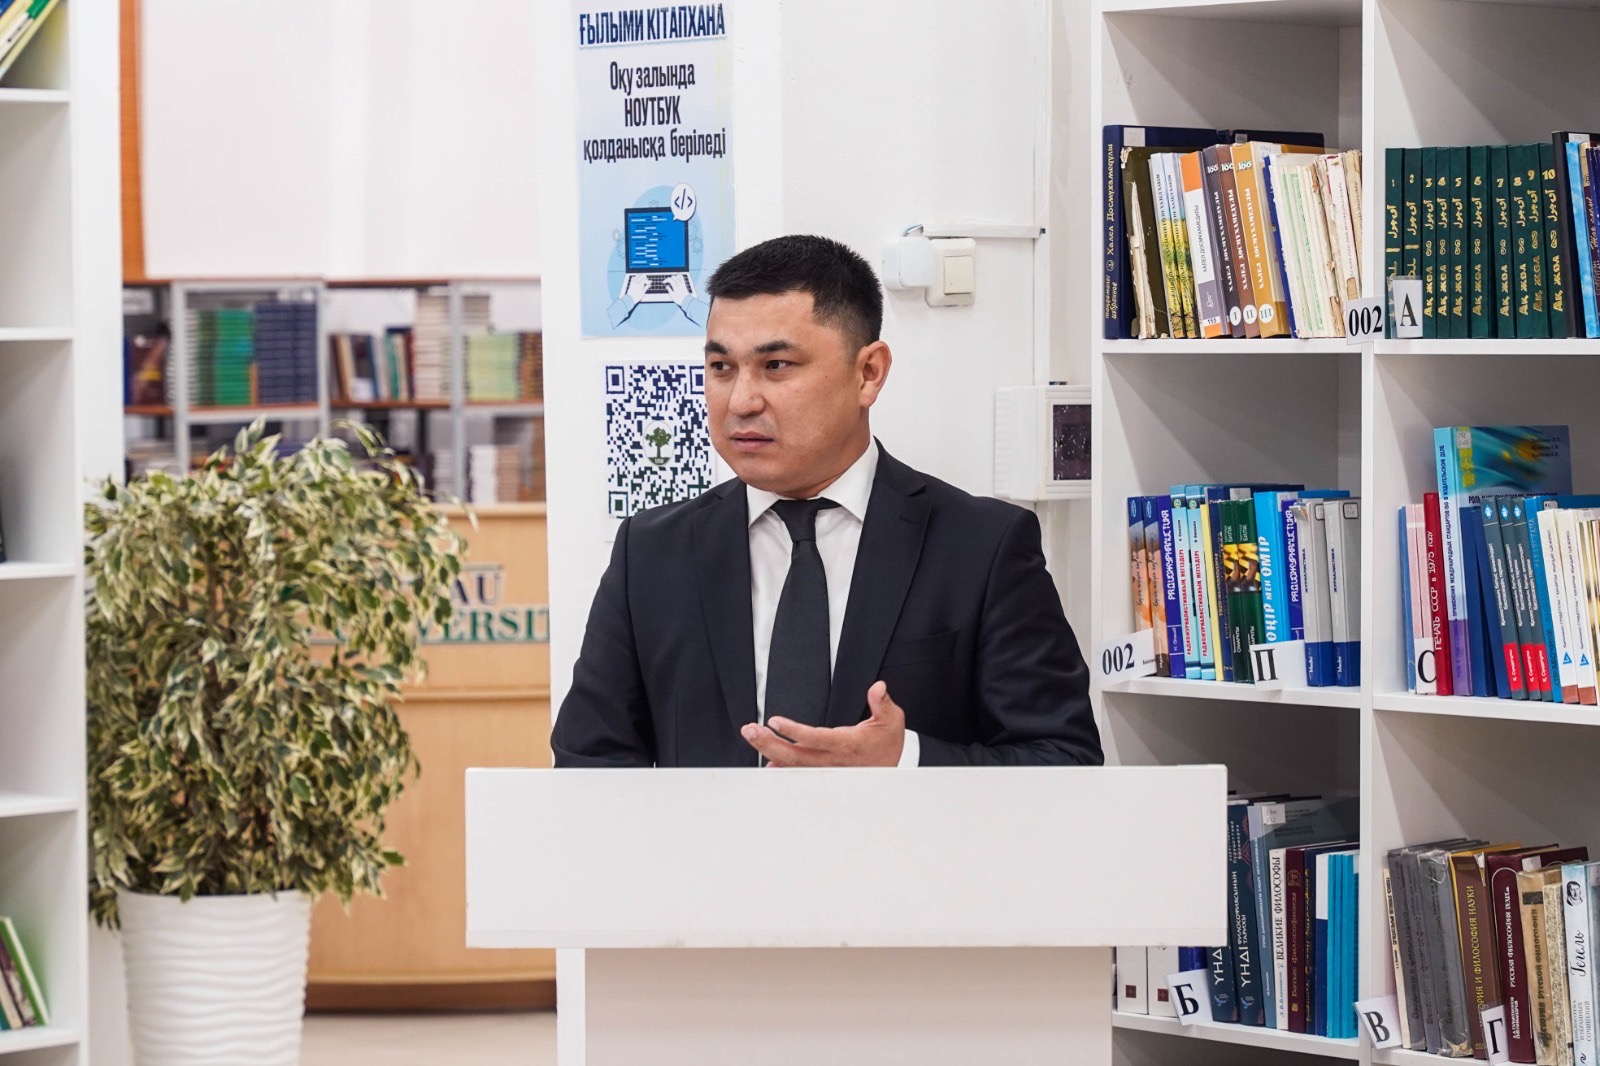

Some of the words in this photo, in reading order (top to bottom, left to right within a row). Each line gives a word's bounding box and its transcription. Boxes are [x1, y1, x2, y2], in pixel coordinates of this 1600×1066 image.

[579, 9, 644, 45] ҒЫЛЫМИ
[647, 3, 725, 40] КІТАПХАНА
[610, 61, 634, 96] Оқу
[636, 63, 696, 90] залында
[624, 95, 681, 127] НОУТБУК
[583, 136, 666, 164] қолданысқа
[670, 127, 726, 163] беріледі
[1426, 178, 1432, 187] 3
[1438, 177, 1445, 186] 4
[1456, 178, 1462, 186] 5
[1474, 176, 1482, 185] 6
[1497, 179, 1504, 187] 7
[1514, 177, 1522, 186] 8
[1528, 170, 1535, 180] 9
[1543, 169, 1555, 180] 10
[1349, 305, 1383, 336] 002
[1400, 293, 1418, 327] А
[1162, 510, 1176, 600] РАДИОЖУРНАЛИСТИКА
[1258, 536, 1272, 577] ӨМІР
[1431, 587, 1439, 612] СССР
[1263, 604, 1278, 641] ӨҢІР
[1433, 617, 1442, 650] ПЕЧАТЬ
[1102, 642, 1135, 675] 002
[1252, 648, 1279, 682] П
[1272, 857, 1282, 914] ФИЛОСОФЫ
[1466, 885, 1475, 915] НАУКИ
[1274, 918, 1285, 960] ВЕЛИКИЕ
[1469, 917, 1481, 975] ФИЛОСОФИЯ
[1569, 930, 1586, 977] Гегель
[1172, 983, 1199, 1017] Б
[1362, 1010, 1390, 1043] В
[1487, 1018, 1503, 1055] Г
